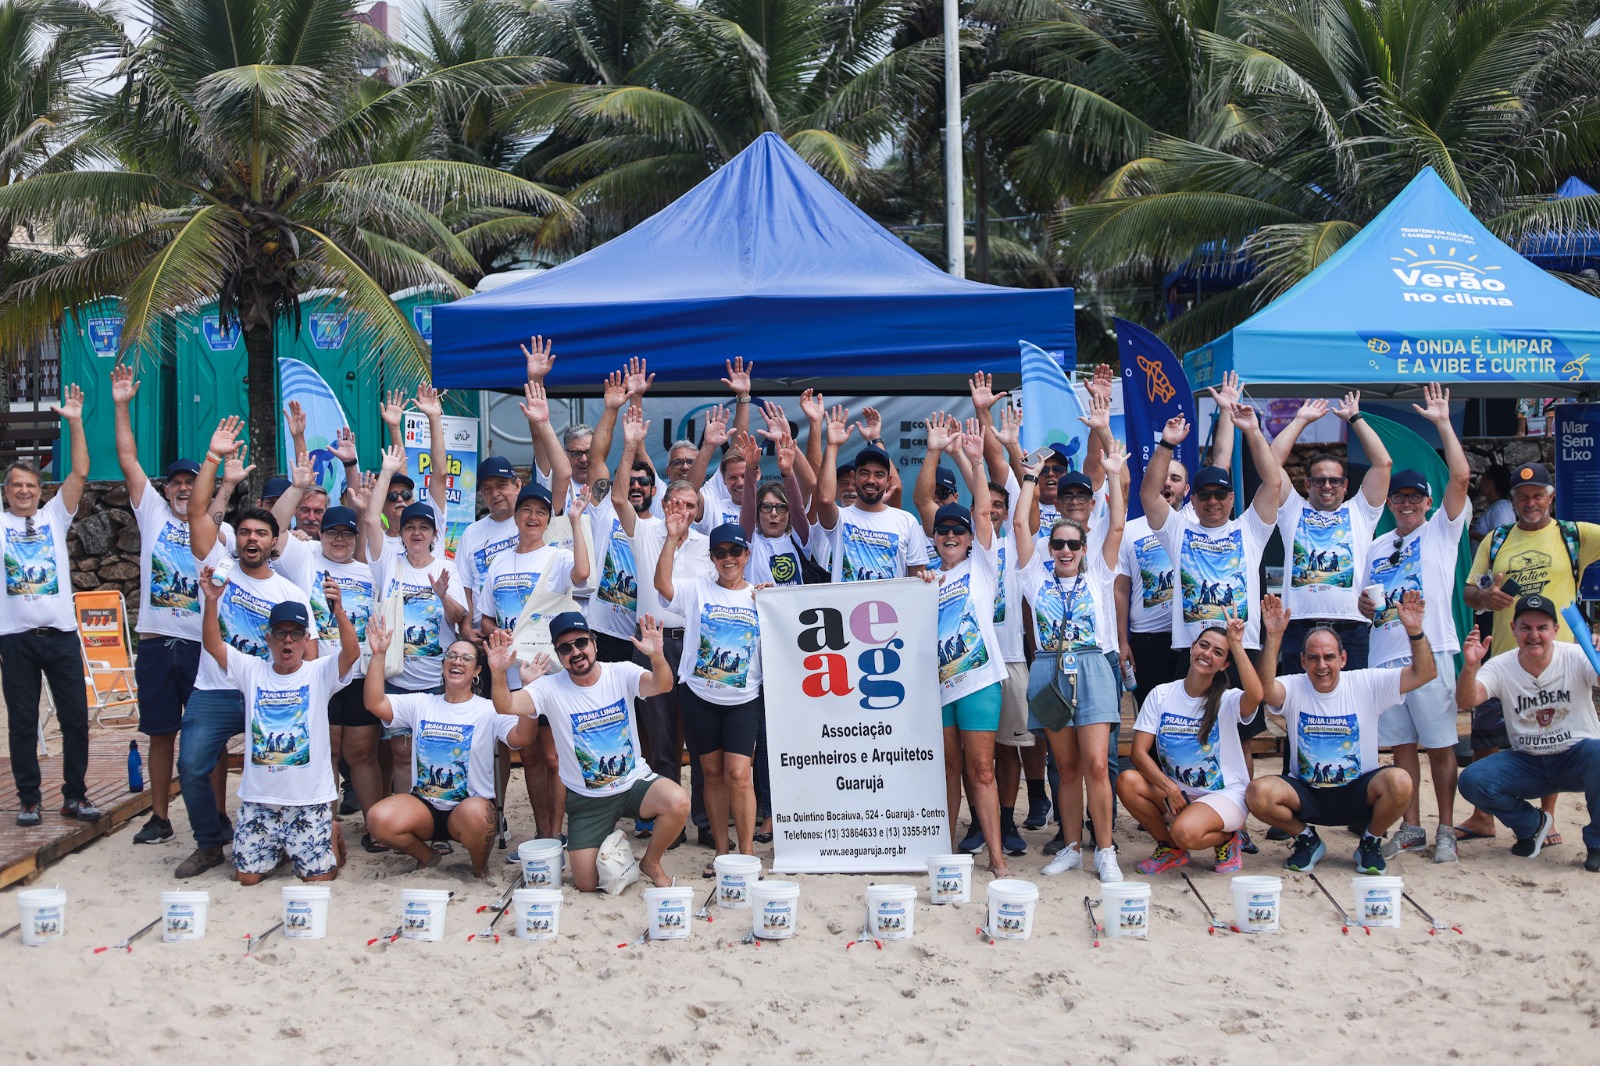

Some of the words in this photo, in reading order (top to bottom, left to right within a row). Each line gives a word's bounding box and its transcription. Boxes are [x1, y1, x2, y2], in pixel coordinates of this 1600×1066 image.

[1392, 268, 1506, 292] Verão
[1404, 292, 1437, 303] no
[1442, 292, 1514, 307] clima
[1399, 340, 1412, 354] A
[1416, 339, 1466, 354] ONDA
[1471, 336, 1483, 354] É
[1486, 339, 1553, 354] LIMPAR
[1397, 358, 1408, 374] E
[1413, 358, 1426, 374] A
[1430, 358, 1471, 374] VIBE
[1476, 355, 1487, 374] É
[1490, 357, 1556, 374] CURTIR
[1562, 421, 1588, 434] Mar
[1562, 434, 1594, 447] Sem
[1562, 448, 1592, 461] Lixo
[485, 543, 509, 556] PRAIA
[252, 596, 273, 611] LIMPA
[712, 606, 734, 614] PRAIA
[734, 608, 755, 618] LIMPA
[797, 600, 899, 652] ae
[802, 638, 905, 710] ag
[1514, 695, 1538, 714] JIM
[1538, 690, 1571, 706] BEAM
[578, 711, 600, 723] PRAIA
[600, 704, 621, 717] LIMPA
[1164, 716, 1188, 725] PRAIA
[443, 724, 464, 732] LIMPA
[1308, 717, 1326, 725] PRAIA
[1326, 718, 1348, 726] LIMPA
[821, 721, 893, 740] Associação
[780, 751, 857, 770] Engenheiros
[860, 752, 868, 763] e
[872, 747, 934, 765] Arquitetos
[836, 775, 884, 793] Guarujá
[776, 813, 791, 823] Rua
[793, 812, 825, 823] Quintino
[826, 811, 864, 822] Bocaiuva,
[865, 810, 879, 820] 524
[885, 808, 915, 821] Guarujá
[921, 808, 946, 818] Centro
[784, 830, 823, 841] Telefones:
[824, 829, 839, 841] (13)
[841, 828, 877, 839] 33864633
[886, 827, 900, 839] (13)
[902, 826, 940, 837] 3355-9137
[820, 845, 907, 858] www.aeaguaruja.org.br
